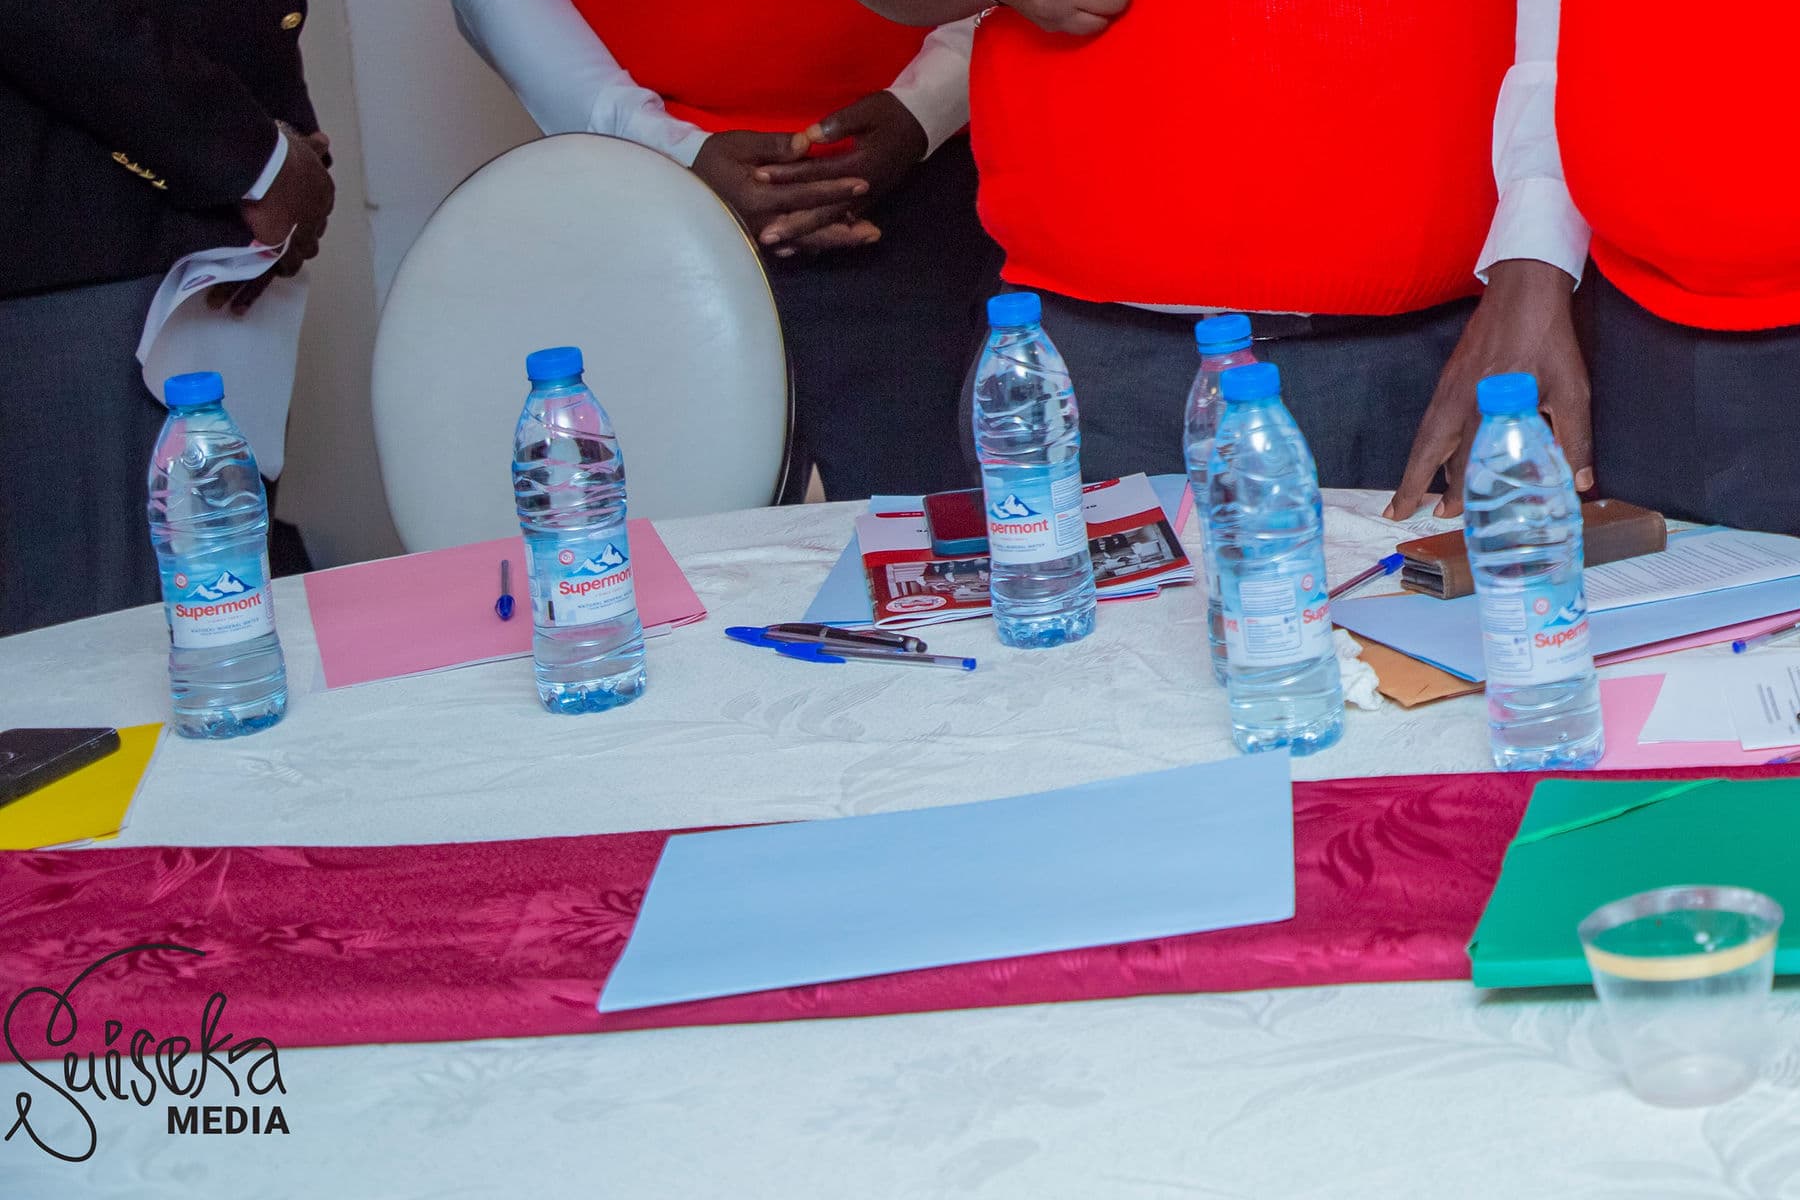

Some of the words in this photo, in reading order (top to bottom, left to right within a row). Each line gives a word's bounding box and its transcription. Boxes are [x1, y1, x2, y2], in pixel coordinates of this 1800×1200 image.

[991, 519, 1048, 535] permont
[559, 566, 632, 595] Supermon
[175, 592, 262, 620] Supermont
